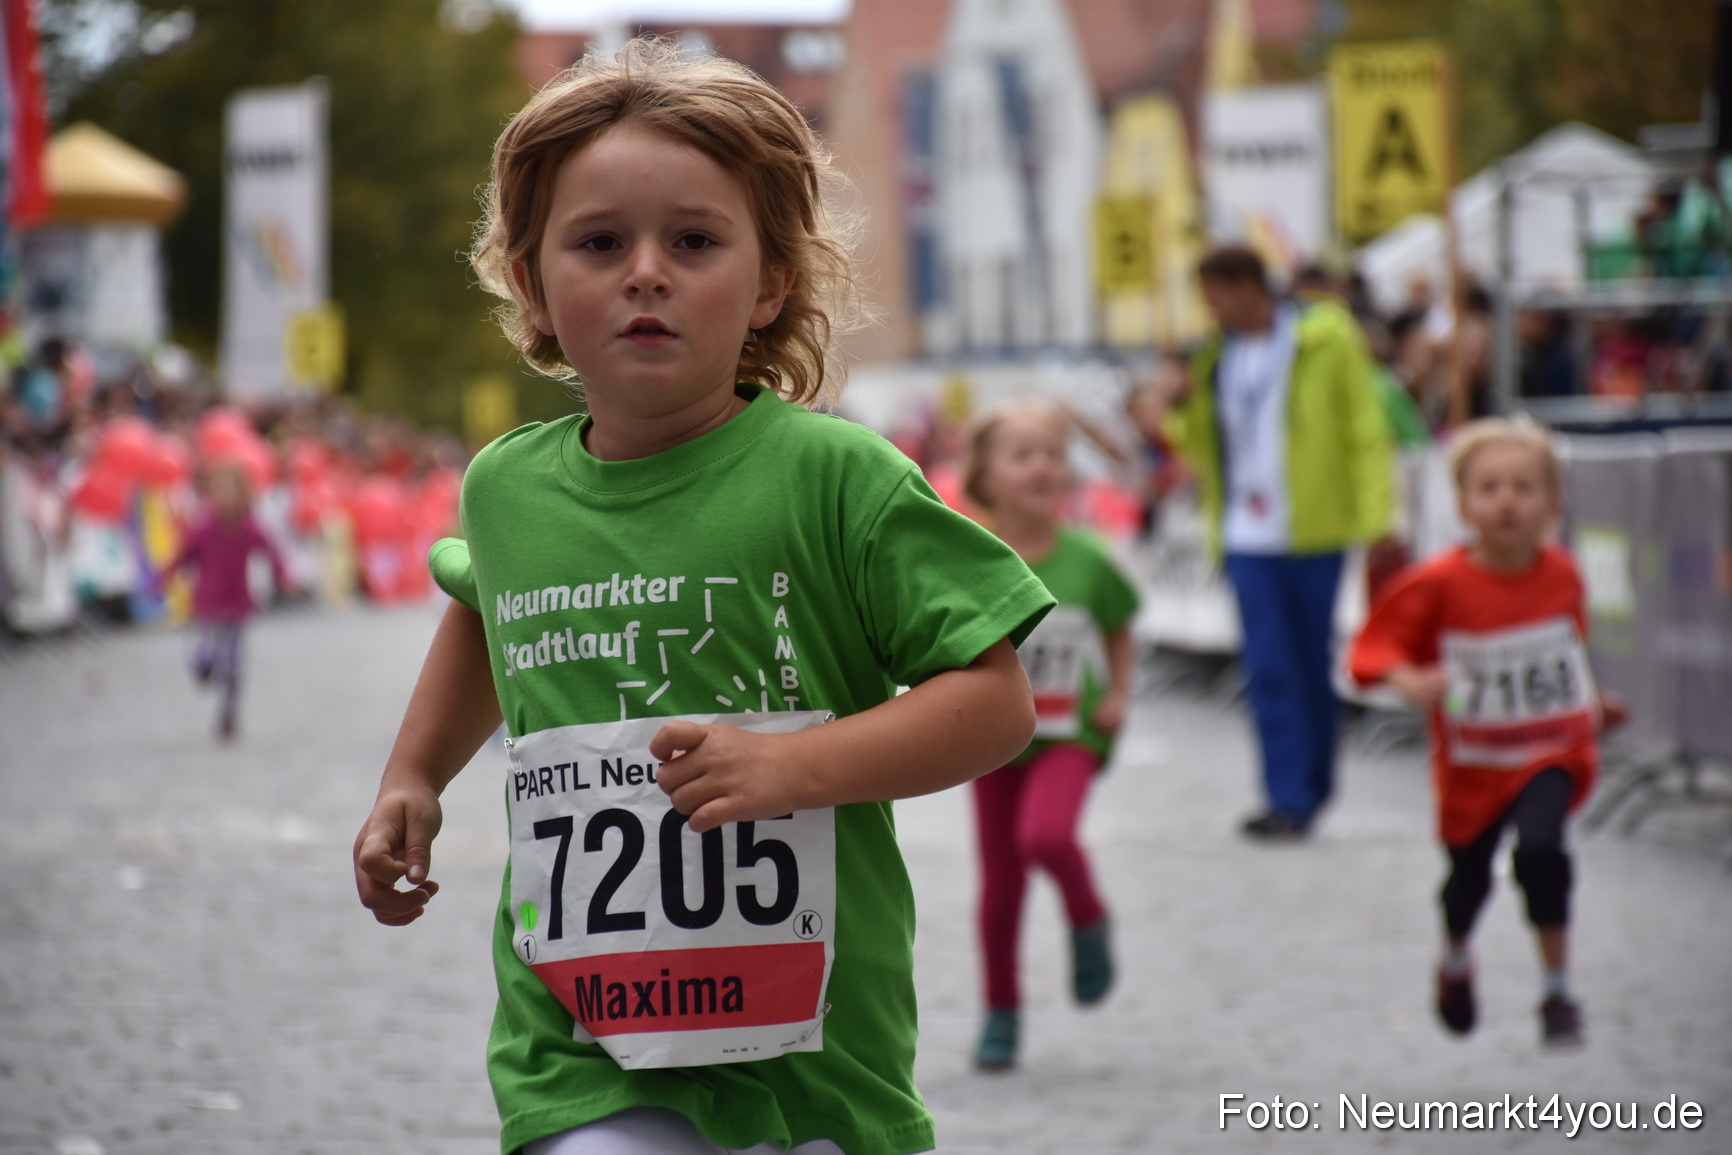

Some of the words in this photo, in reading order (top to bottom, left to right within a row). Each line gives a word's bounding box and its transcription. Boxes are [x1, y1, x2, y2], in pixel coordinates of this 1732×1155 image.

[1365, 106, 1426, 180] A
[496, 573, 685, 625] Neumarkter
[514, 762, 591, 801] PARTL
[533, 808, 799, 941] 7205
[801, 914, 814, 935] K
[574, 969, 744, 1023] Maxima
